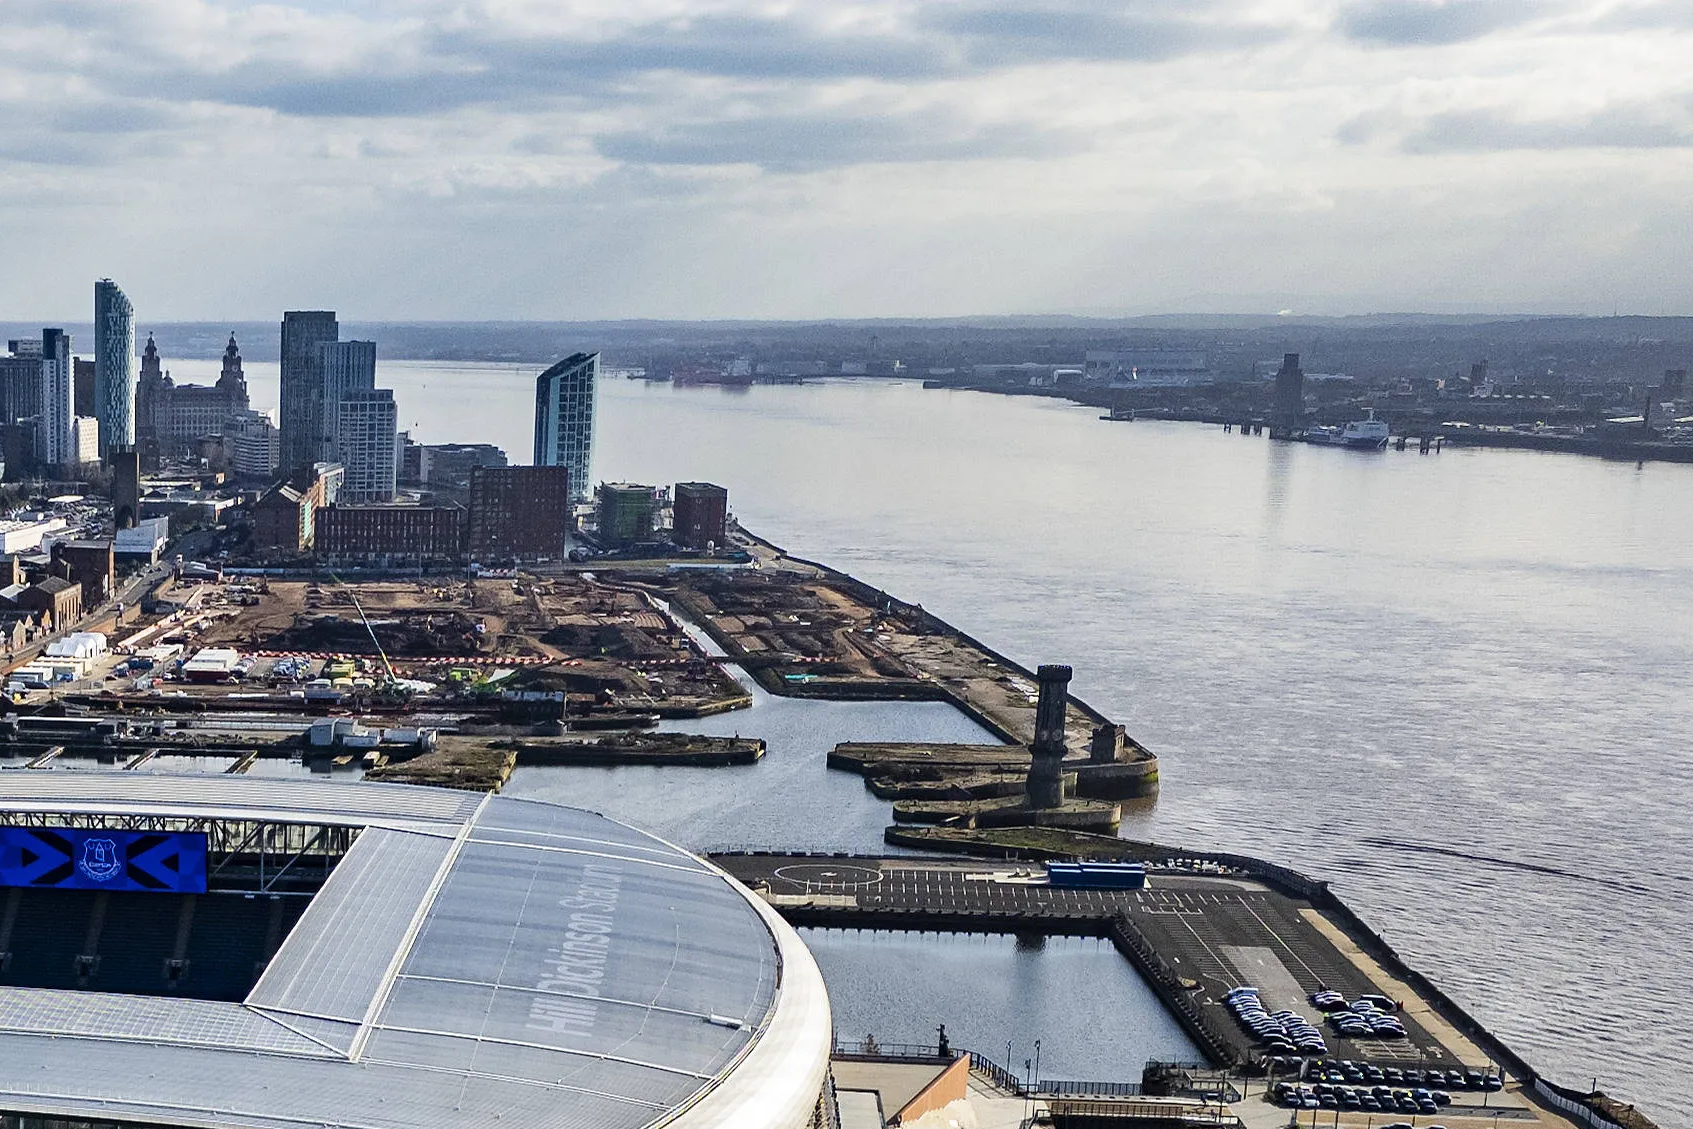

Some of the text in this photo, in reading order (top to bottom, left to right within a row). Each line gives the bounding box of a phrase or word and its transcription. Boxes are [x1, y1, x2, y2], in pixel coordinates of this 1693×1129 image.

[525, 864, 623, 1037] Hill Dickinson Stadium
